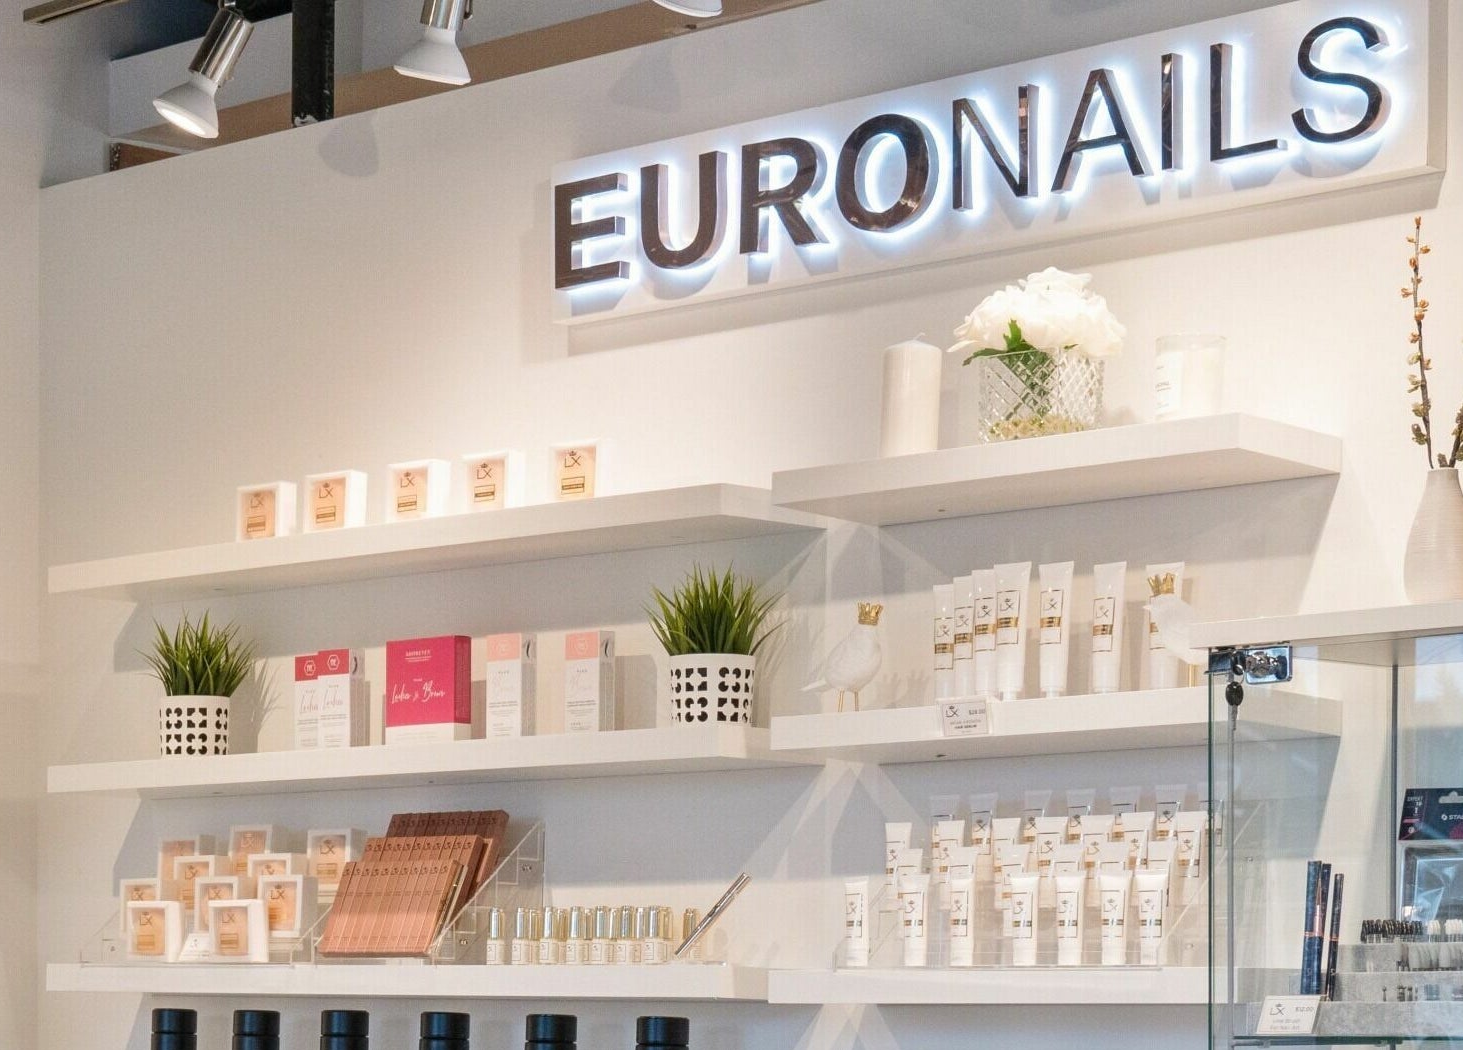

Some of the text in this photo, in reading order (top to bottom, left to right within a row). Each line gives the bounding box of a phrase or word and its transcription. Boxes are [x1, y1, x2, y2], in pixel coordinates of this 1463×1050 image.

[553, 15, 1399, 290] EURONAILS
[564, 454, 581, 469] LX
[477, 466, 493, 480] LX
[400, 476, 416, 488] LX
[318, 486, 334, 499] LX
